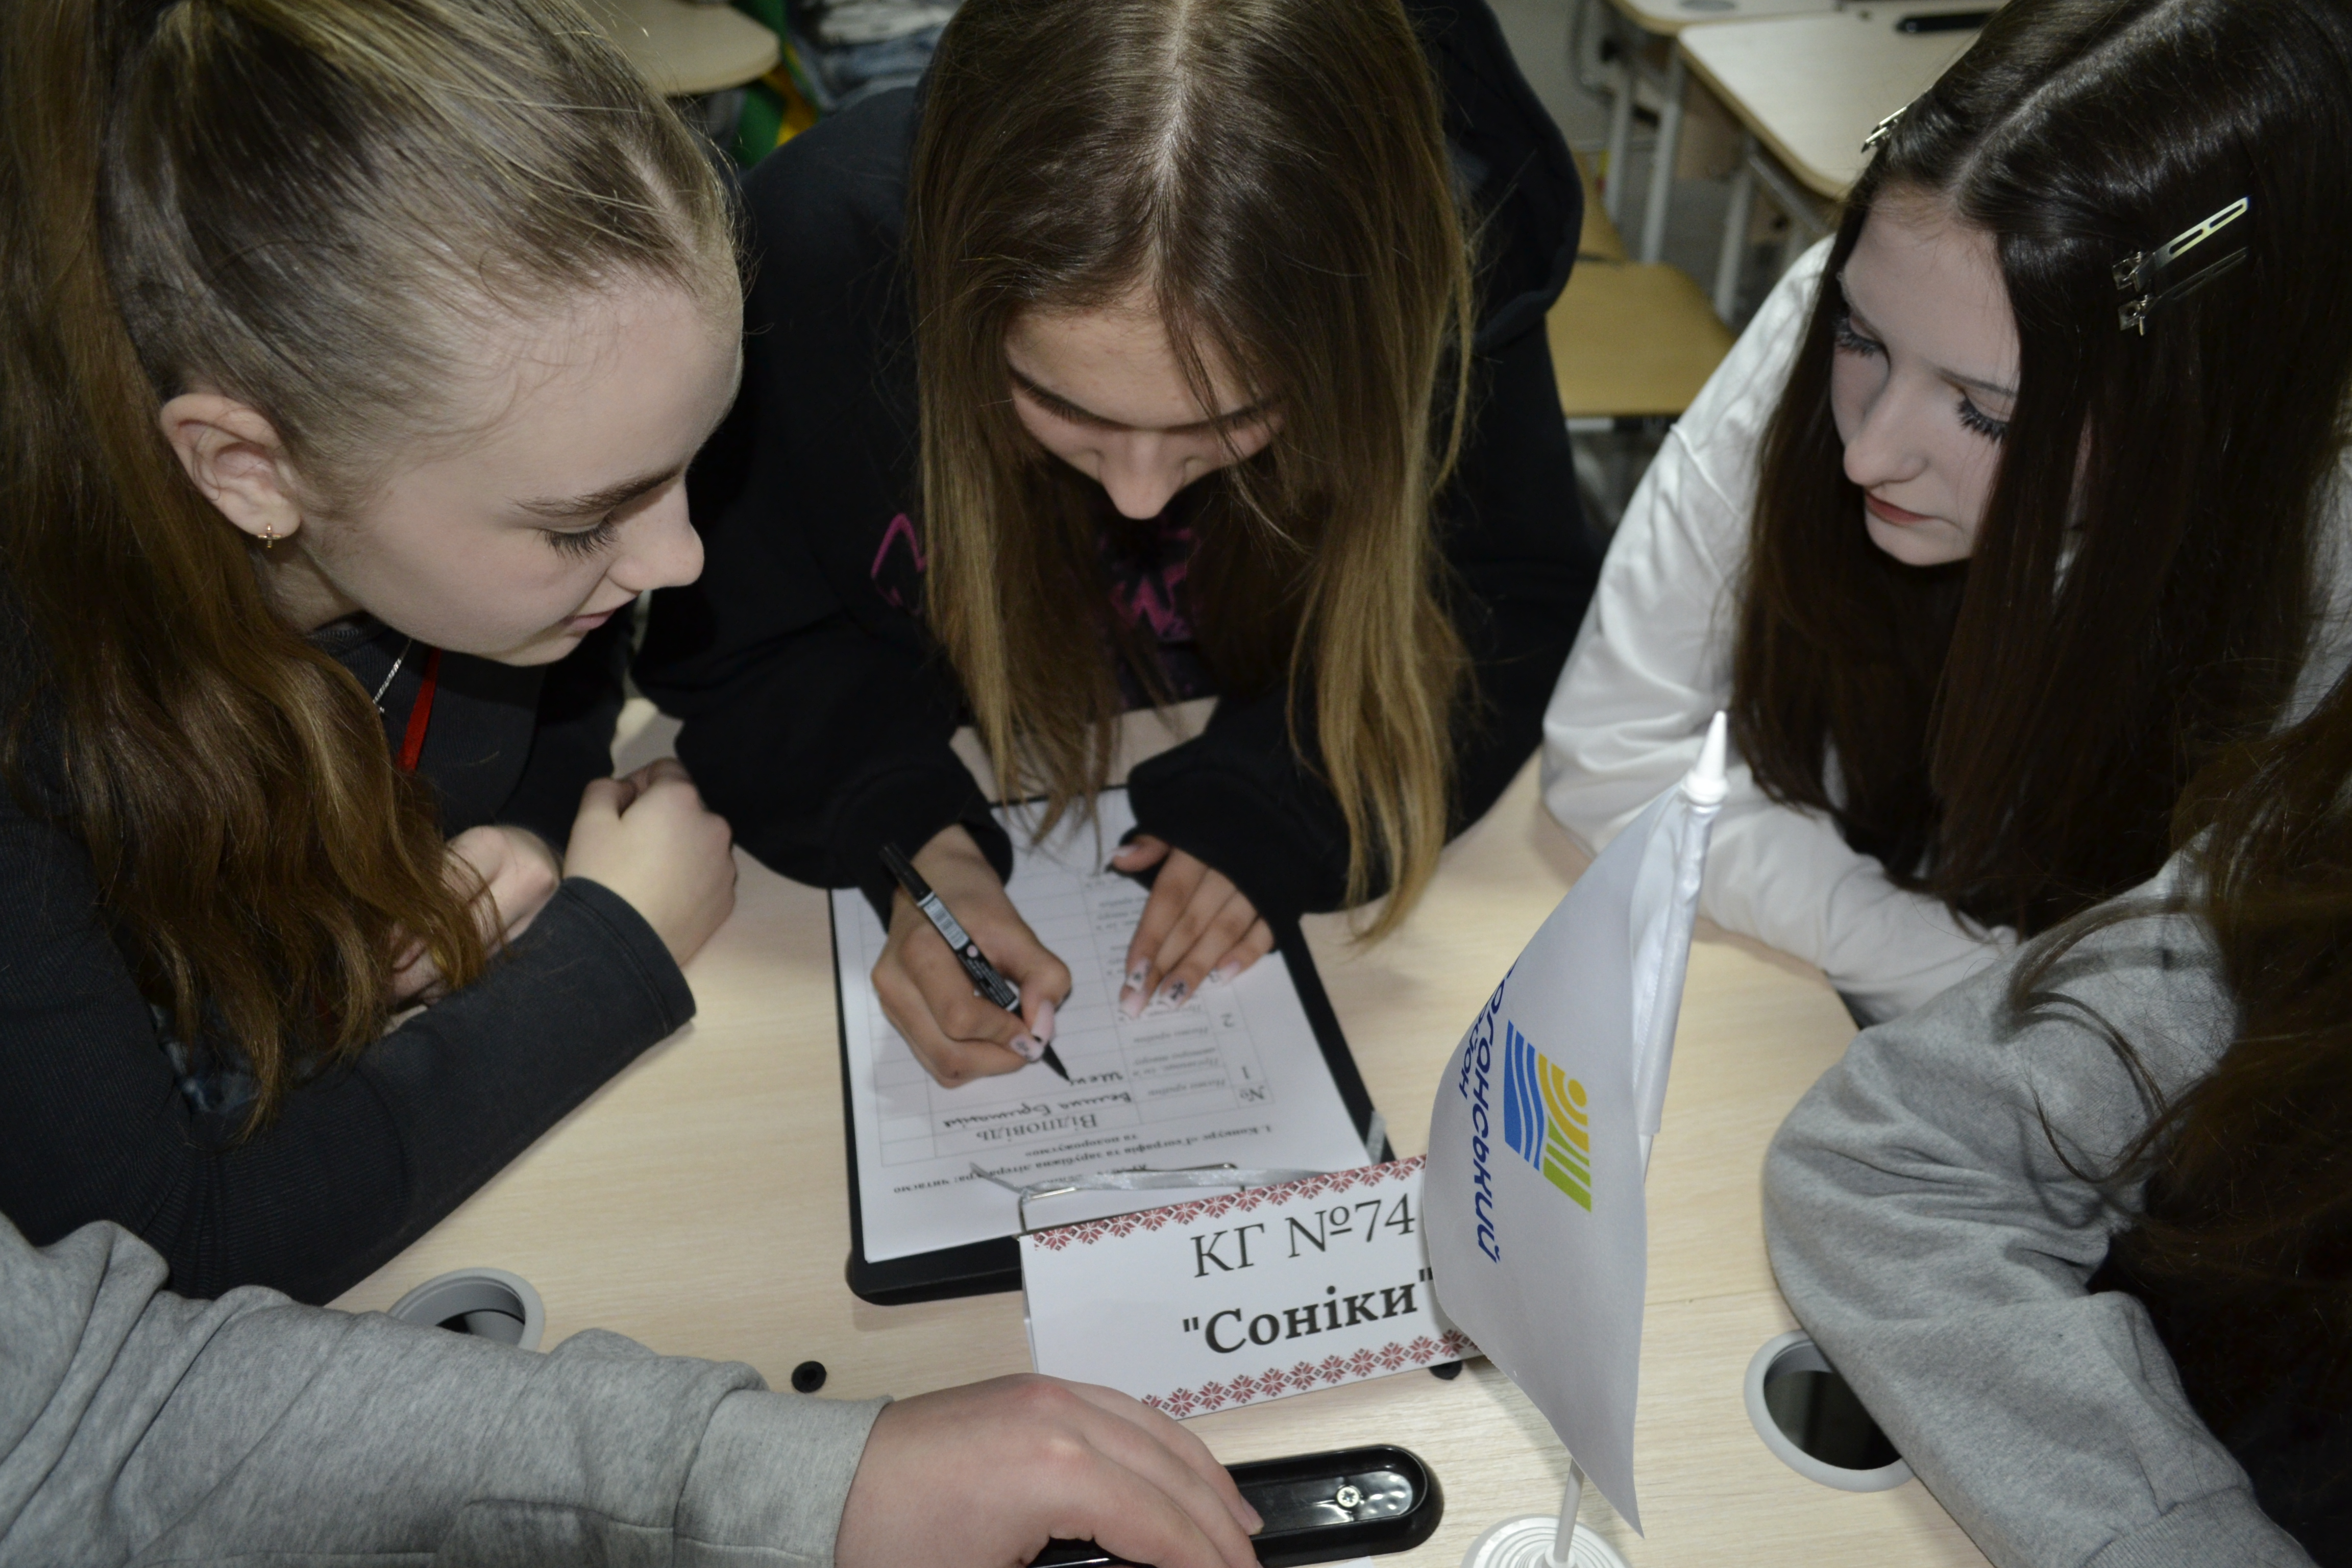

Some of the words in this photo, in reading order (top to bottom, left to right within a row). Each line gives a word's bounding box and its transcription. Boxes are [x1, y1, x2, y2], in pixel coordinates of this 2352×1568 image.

[1220, 1012, 1234, 1028] 2
[1241, 1065, 1250, 1080] 1
[975, 1113, 1098, 1142] Відповідь
[1472, 959, 1520, 1264] аганський
[1190, 1222, 1265, 1278] КГ
[1284, 1192, 1416, 1258] №74
[1182, 1266, 1434, 1354] "Соніки"
